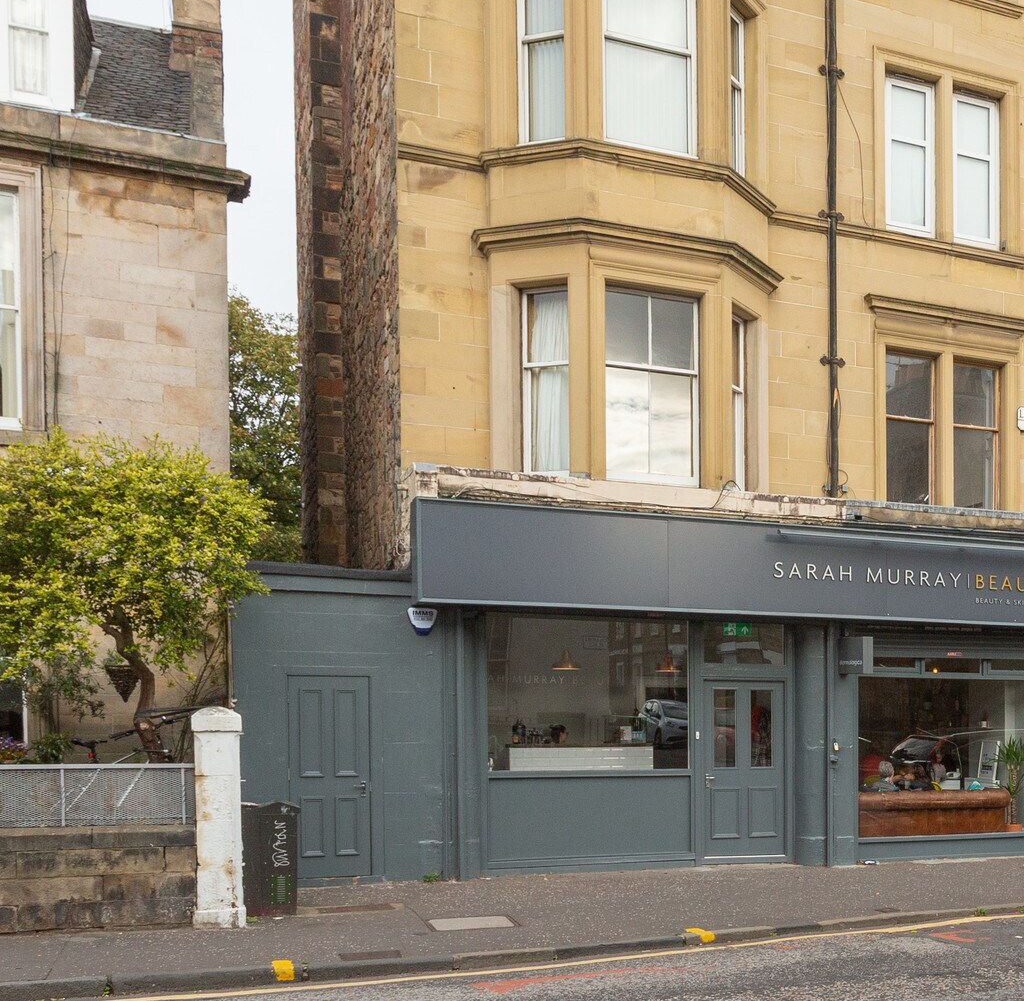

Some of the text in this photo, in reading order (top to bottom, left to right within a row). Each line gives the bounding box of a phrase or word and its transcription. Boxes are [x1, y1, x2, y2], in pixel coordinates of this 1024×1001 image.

[773, 561, 853, 582] SARAH
[866, 567, 961, 589] MURRAY
[975, 597, 1002, 605] BEAUTY
